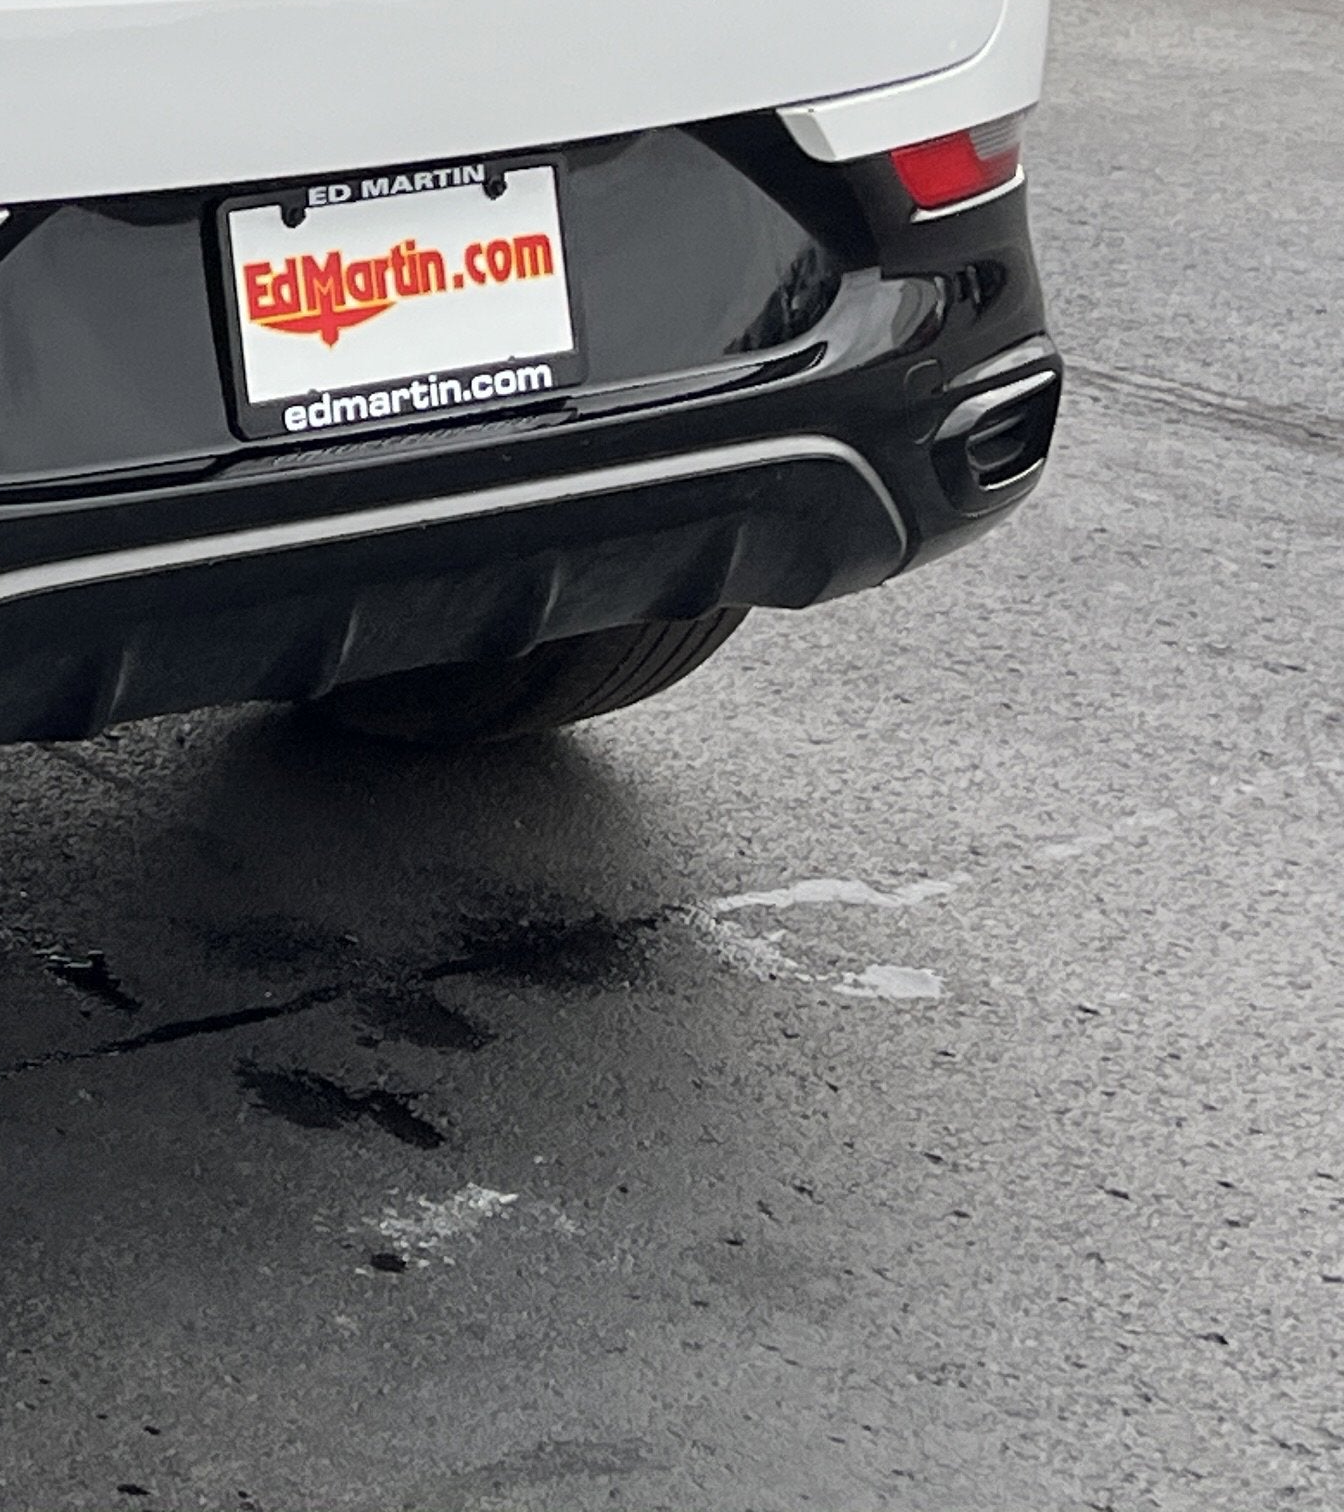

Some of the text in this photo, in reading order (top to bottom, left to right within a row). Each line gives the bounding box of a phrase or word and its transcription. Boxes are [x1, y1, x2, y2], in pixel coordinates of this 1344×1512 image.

[308, 164, 486, 207] ED MARTIN
[283, 362, 553, 432] edmartin.com
